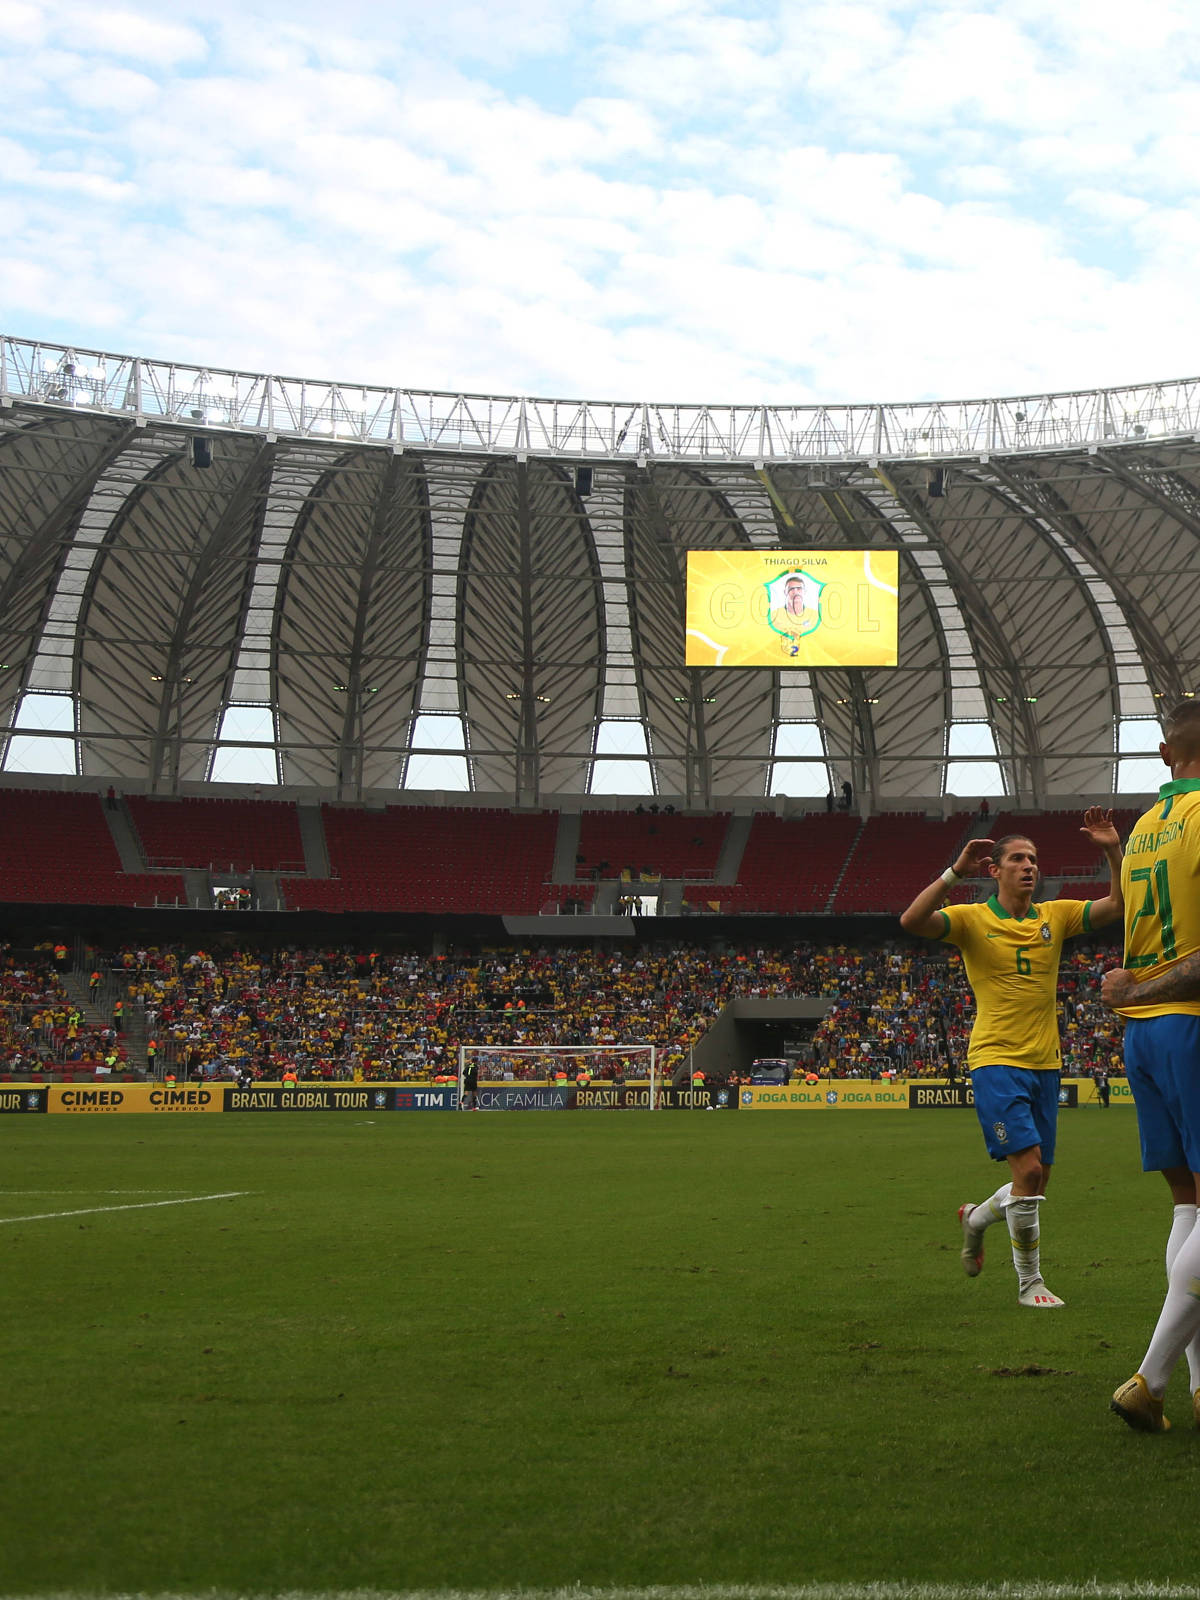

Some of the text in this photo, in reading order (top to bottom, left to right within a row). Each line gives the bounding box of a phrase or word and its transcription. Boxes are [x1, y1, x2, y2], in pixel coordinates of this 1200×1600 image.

[764, 558, 828, 566] THIAGO SILVA
[1123, 858, 1178, 970] 21
[1015, 947, 1032, 975] 6
[61, 1091, 124, 1105] CIMED
[150, 1090, 211, 1105] CIMED
[281, 1092, 331, 1108] GLOBAL
[334, 1092, 369, 1107] TOUR
[414, 1093, 444, 1107] TIM
[625, 1091, 674, 1106] GLOBAL
[677, 1091, 711, 1106] TOUR
[757, 1093, 822, 1103] JOGA BOLA
[841, 1093, 907, 1103] JOGA BOLA
